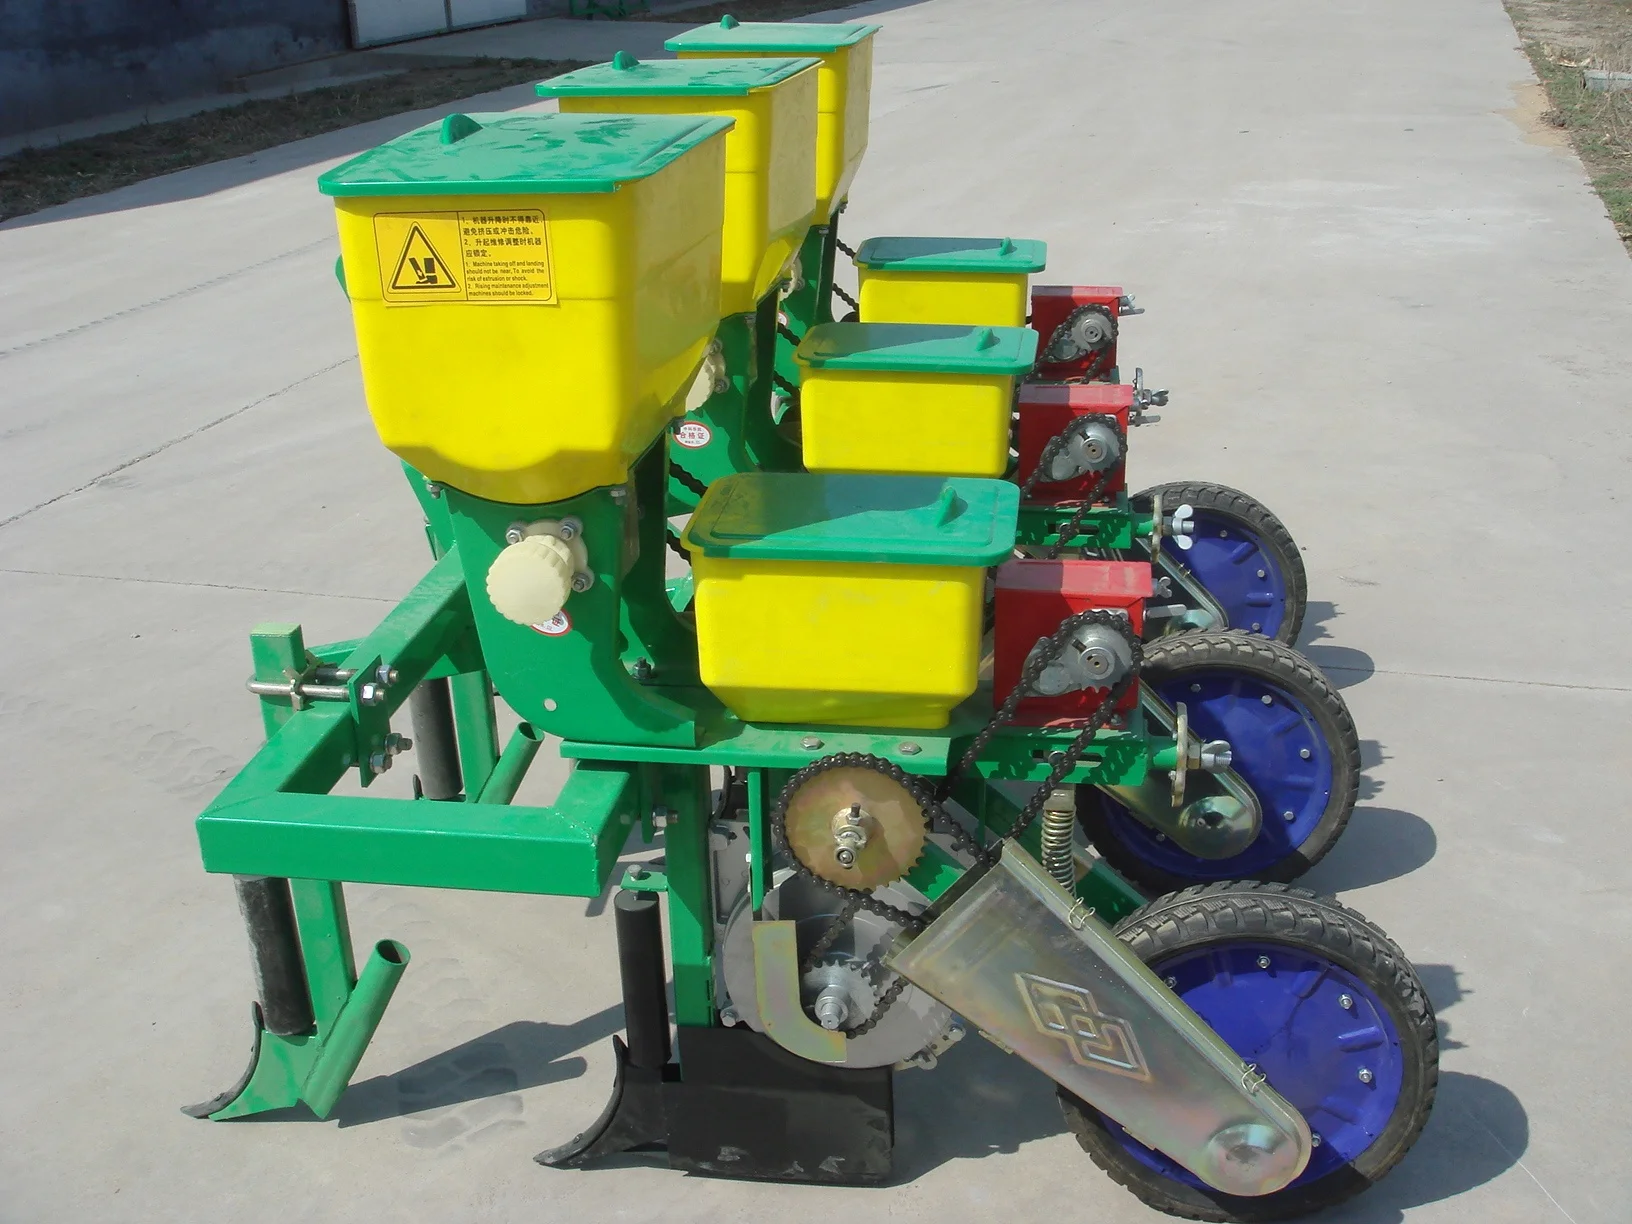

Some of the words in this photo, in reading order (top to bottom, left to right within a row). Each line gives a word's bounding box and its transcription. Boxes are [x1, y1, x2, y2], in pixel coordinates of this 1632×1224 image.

[475, 282, 491, 290] Rising
[522, 282, 549, 290] adjustment
[680, 431, 705, 440] 合格证
